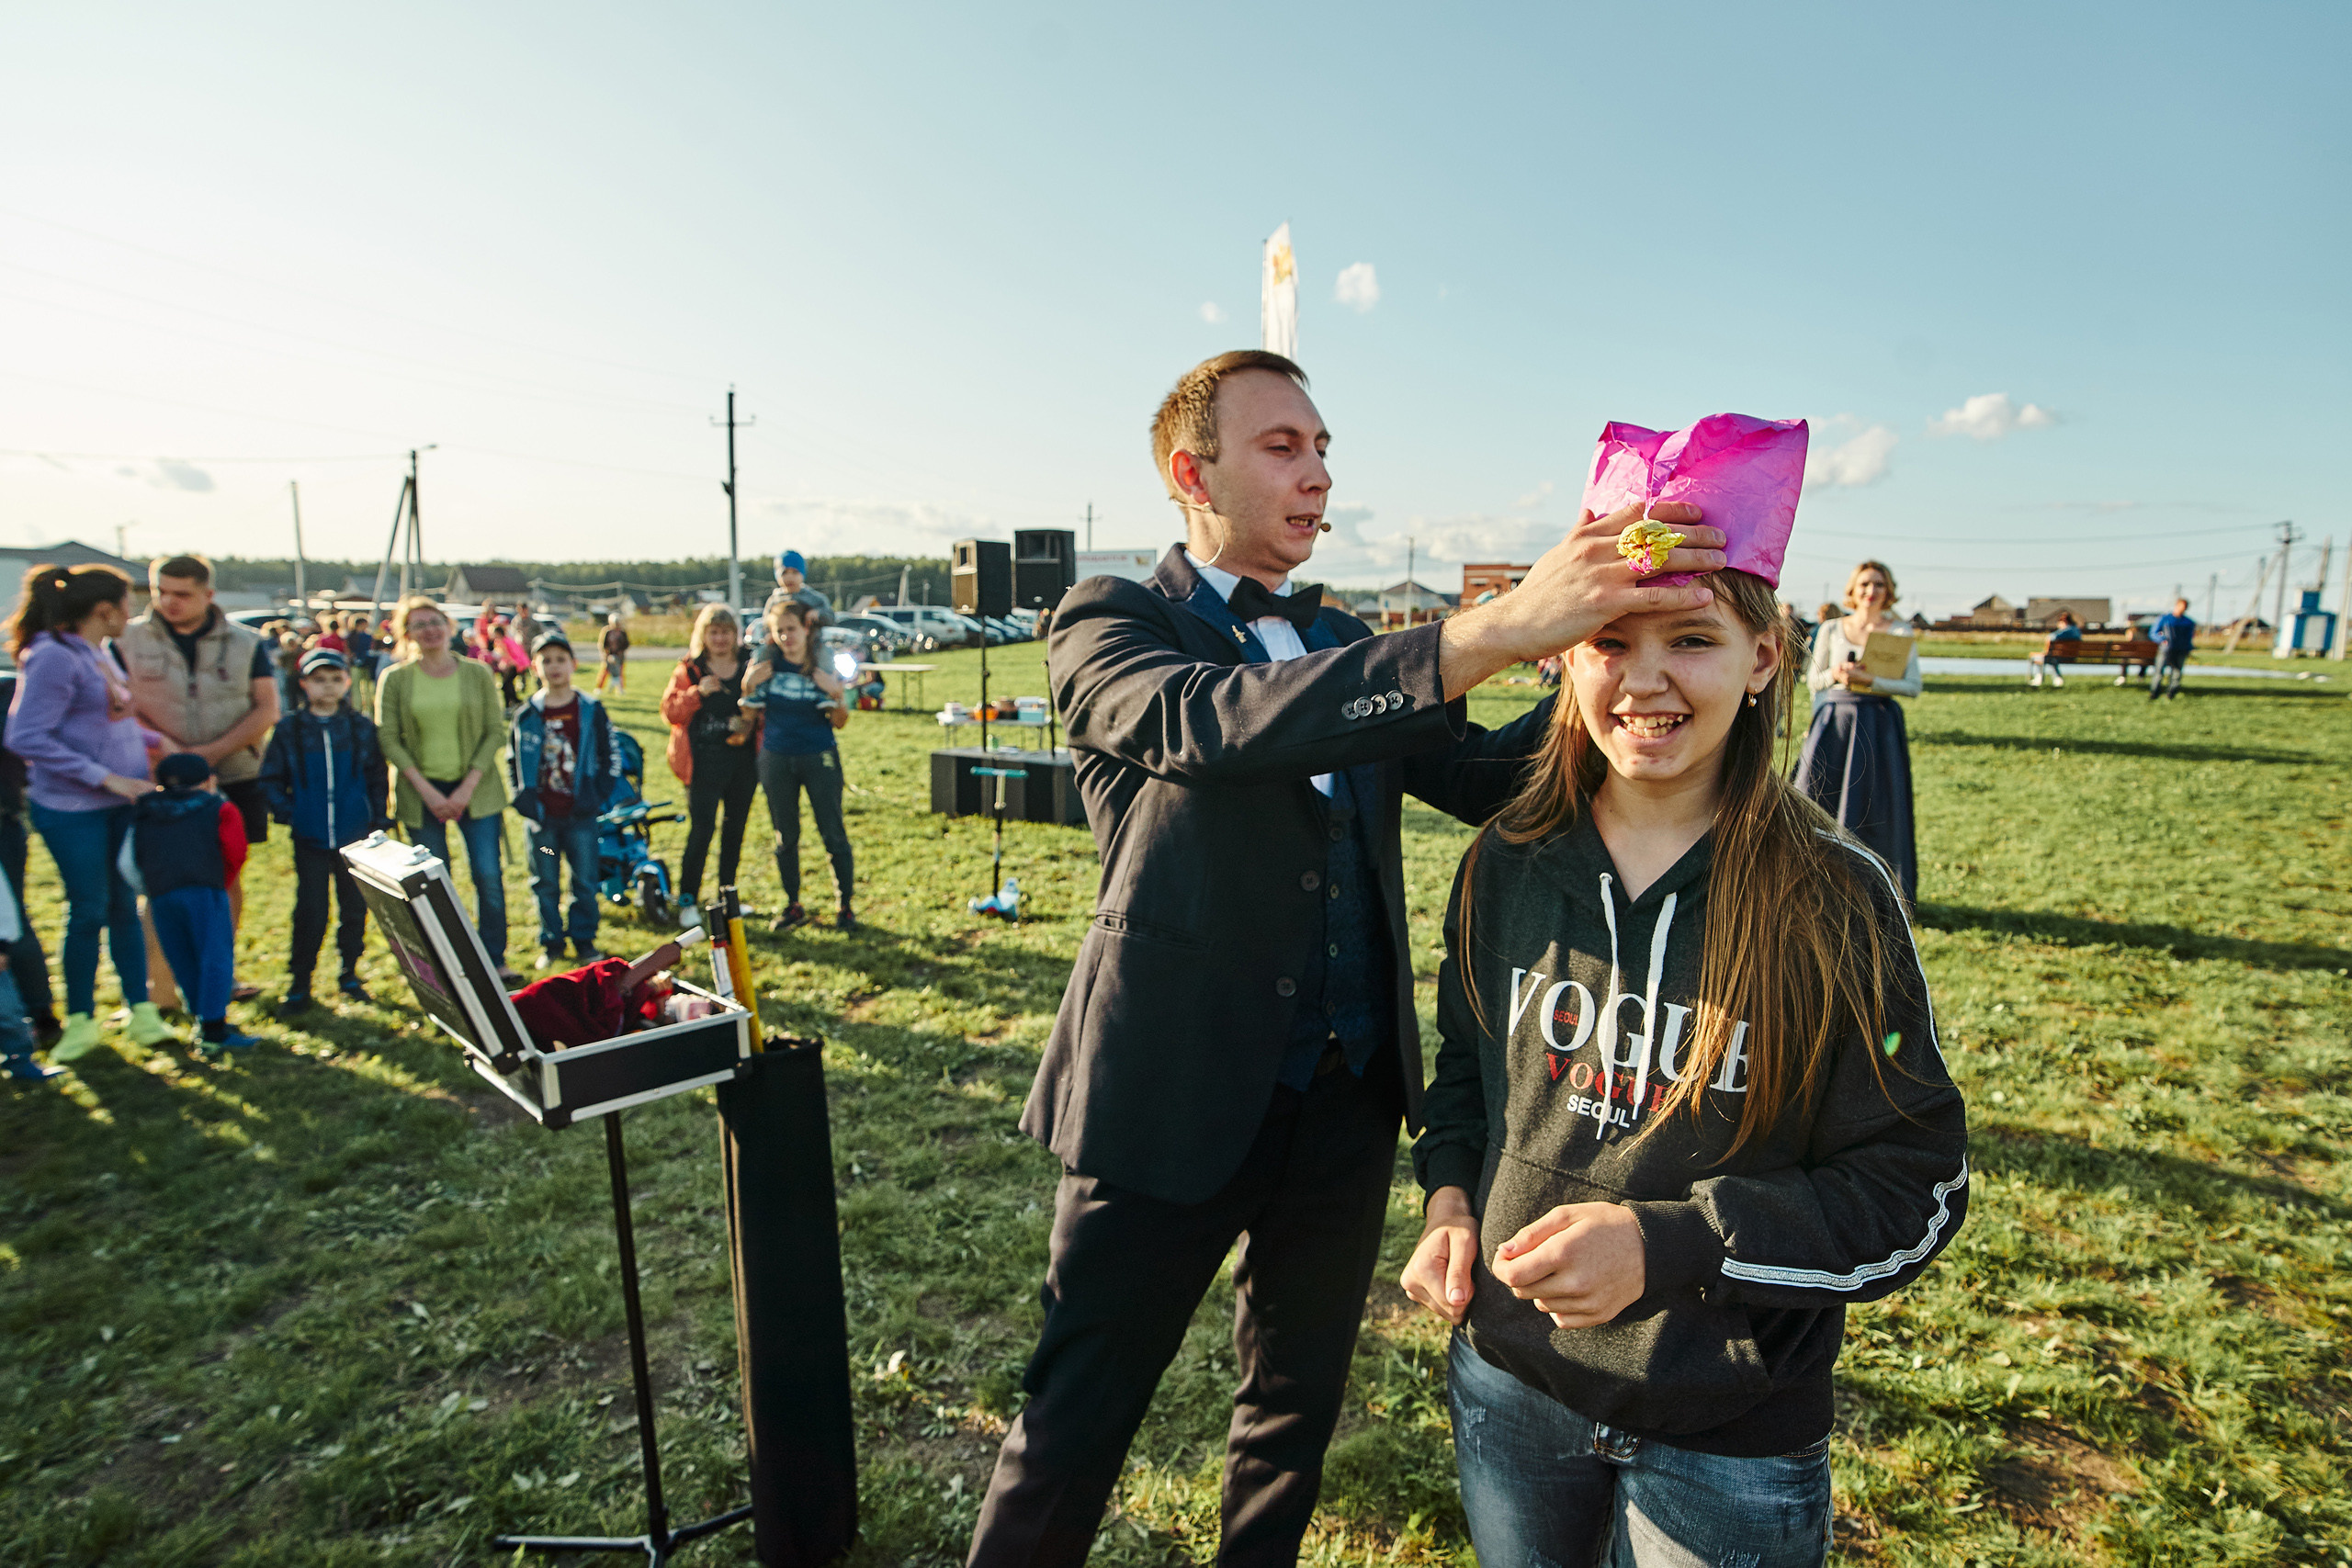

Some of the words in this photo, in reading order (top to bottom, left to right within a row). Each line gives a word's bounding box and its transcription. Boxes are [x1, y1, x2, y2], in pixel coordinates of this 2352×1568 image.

[1508, 967, 1749, 1092] VOGUE
[1554, 1010, 1578, 1026] SEOUL
[1566, 1094, 1631, 1129] SEOUL
